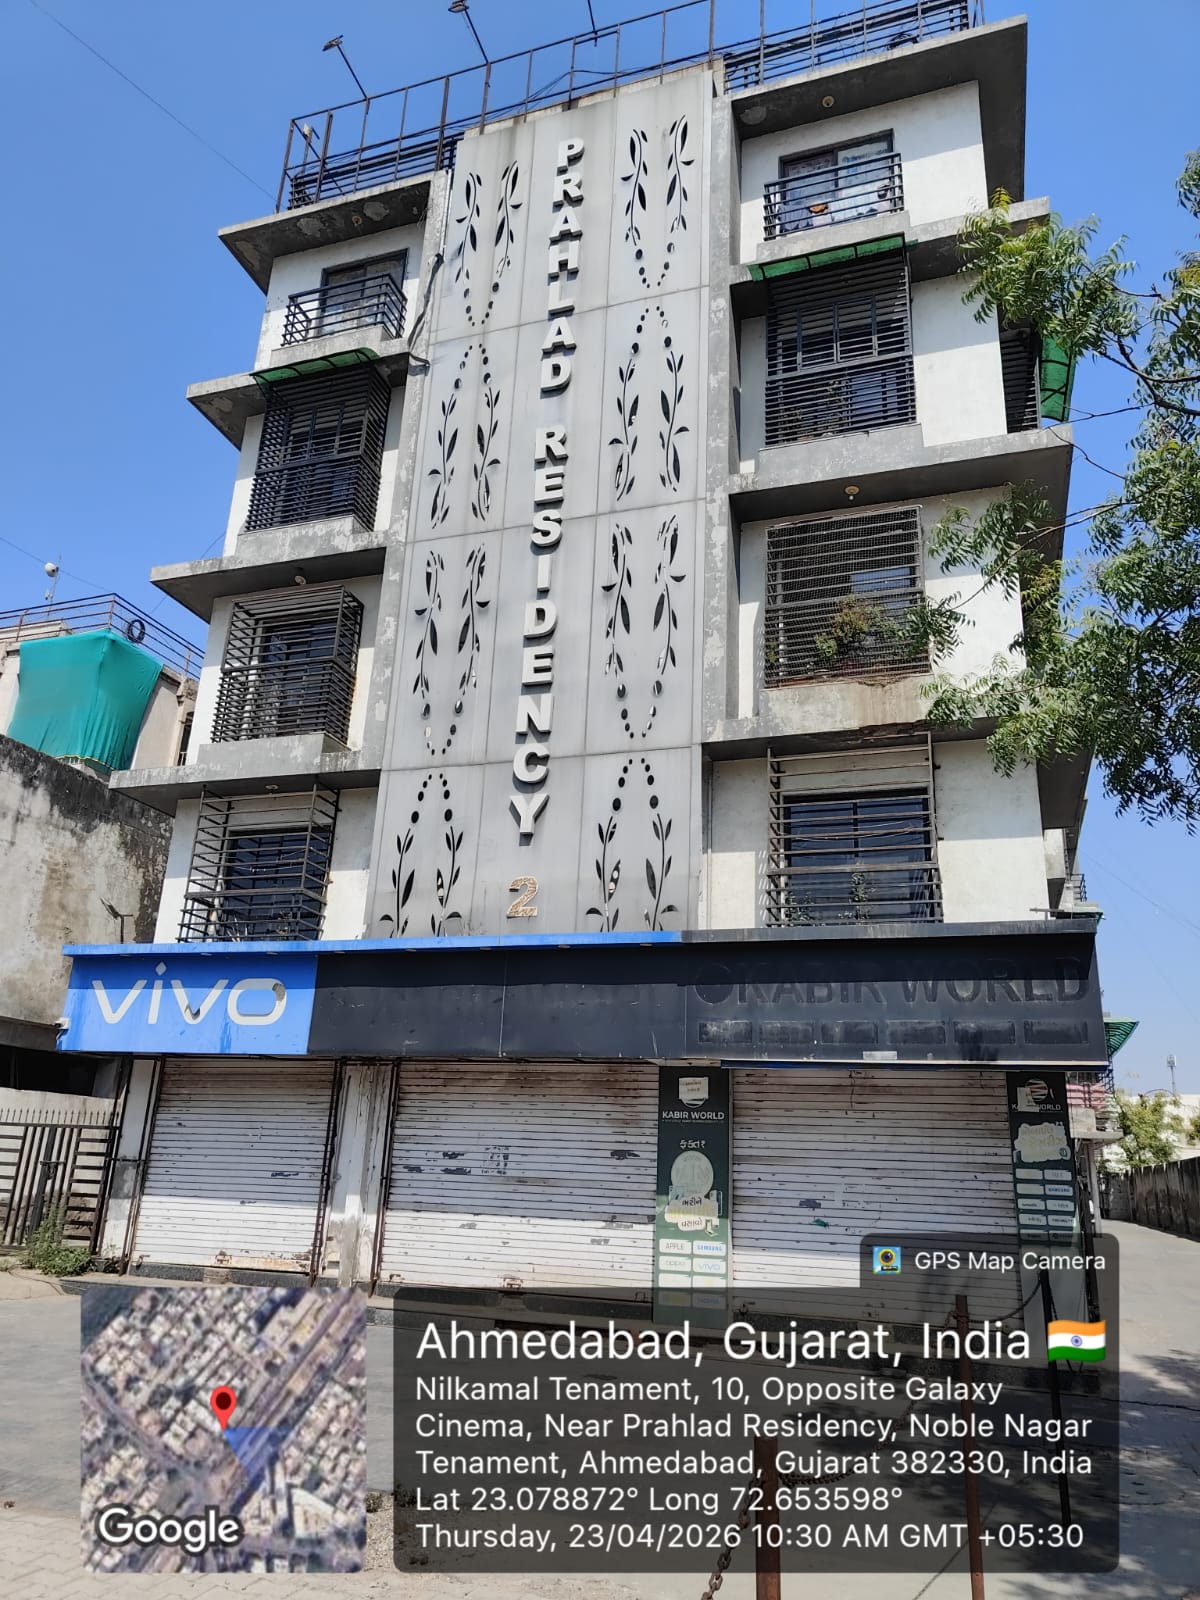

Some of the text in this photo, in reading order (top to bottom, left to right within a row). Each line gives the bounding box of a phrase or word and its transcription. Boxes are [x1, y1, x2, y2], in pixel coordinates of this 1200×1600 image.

[508, 137, 585, 838] PRAHLAD RESIDENCY
[506, 875, 540, 918] 2
[91, 961, 289, 1026] vivo
[736, 956, 1090, 1004] KABIR WORLD
[662, 1111, 725, 1120] KABIR WORLD
